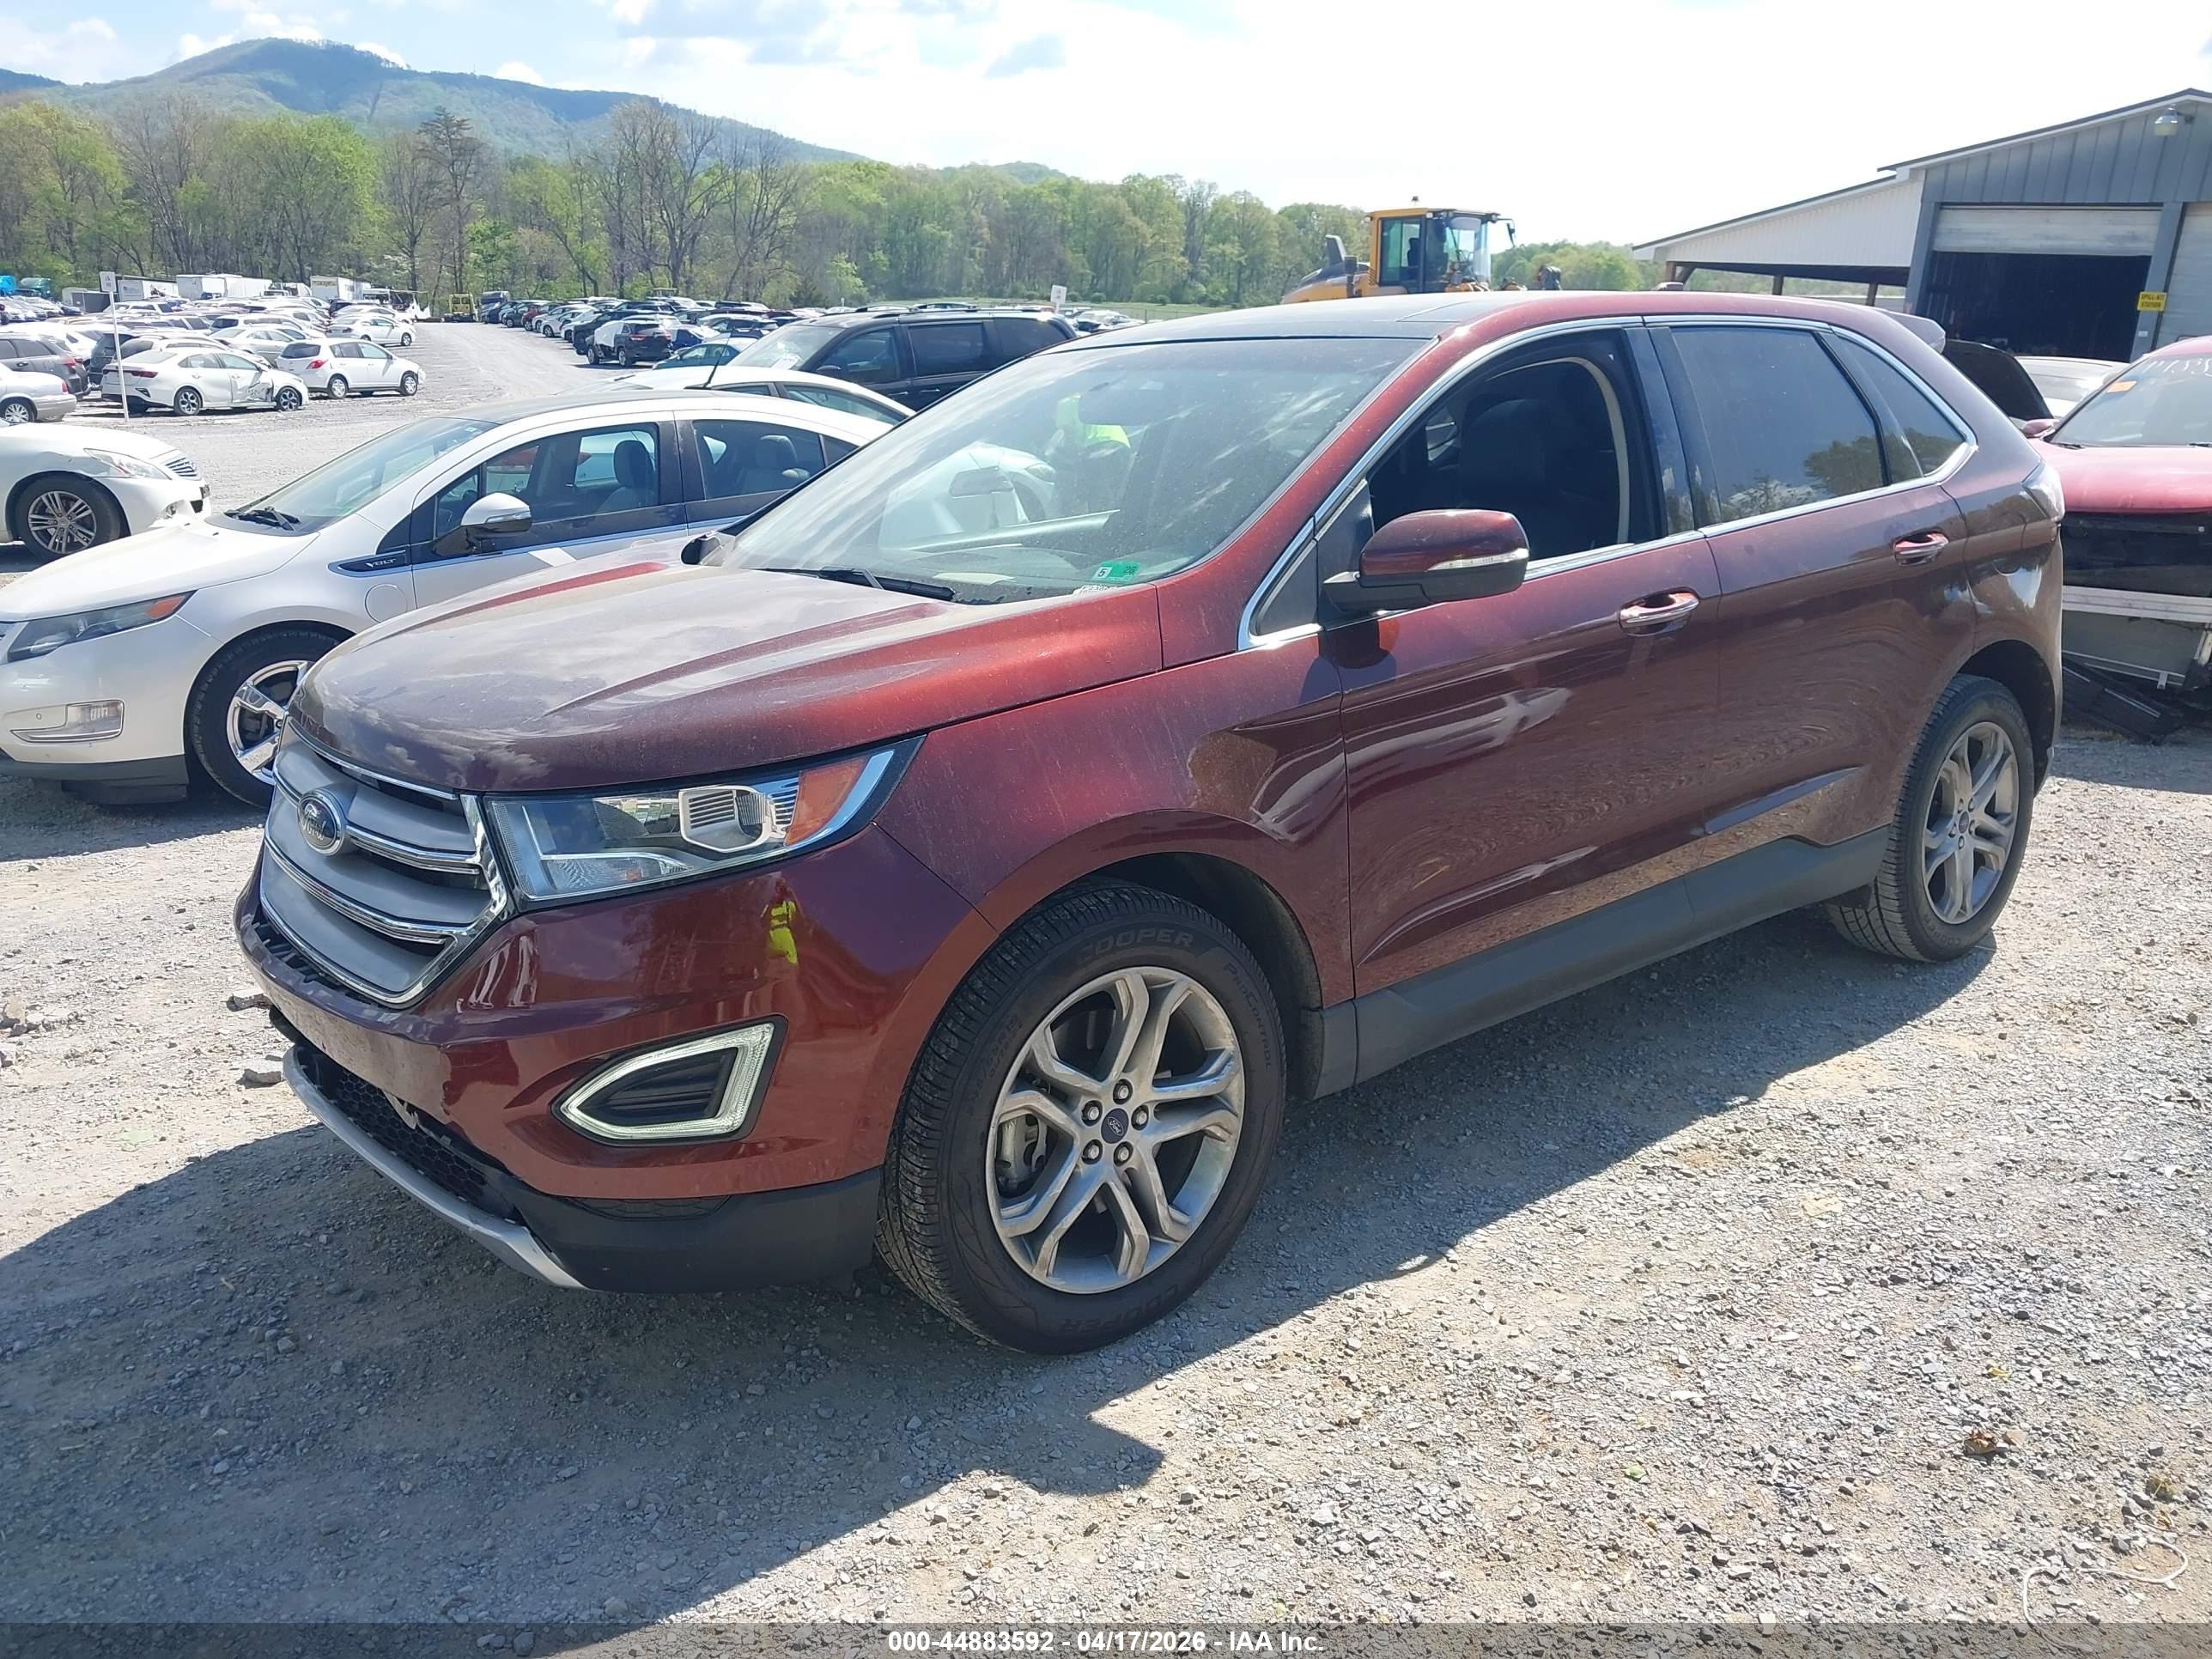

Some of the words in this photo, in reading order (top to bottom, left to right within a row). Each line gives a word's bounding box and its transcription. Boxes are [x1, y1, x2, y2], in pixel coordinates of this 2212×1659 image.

[366, 558, 396, 568] VOLT
[1097, 568, 1106, 577] 5
[1081, 928, 1194, 961] COOPER
